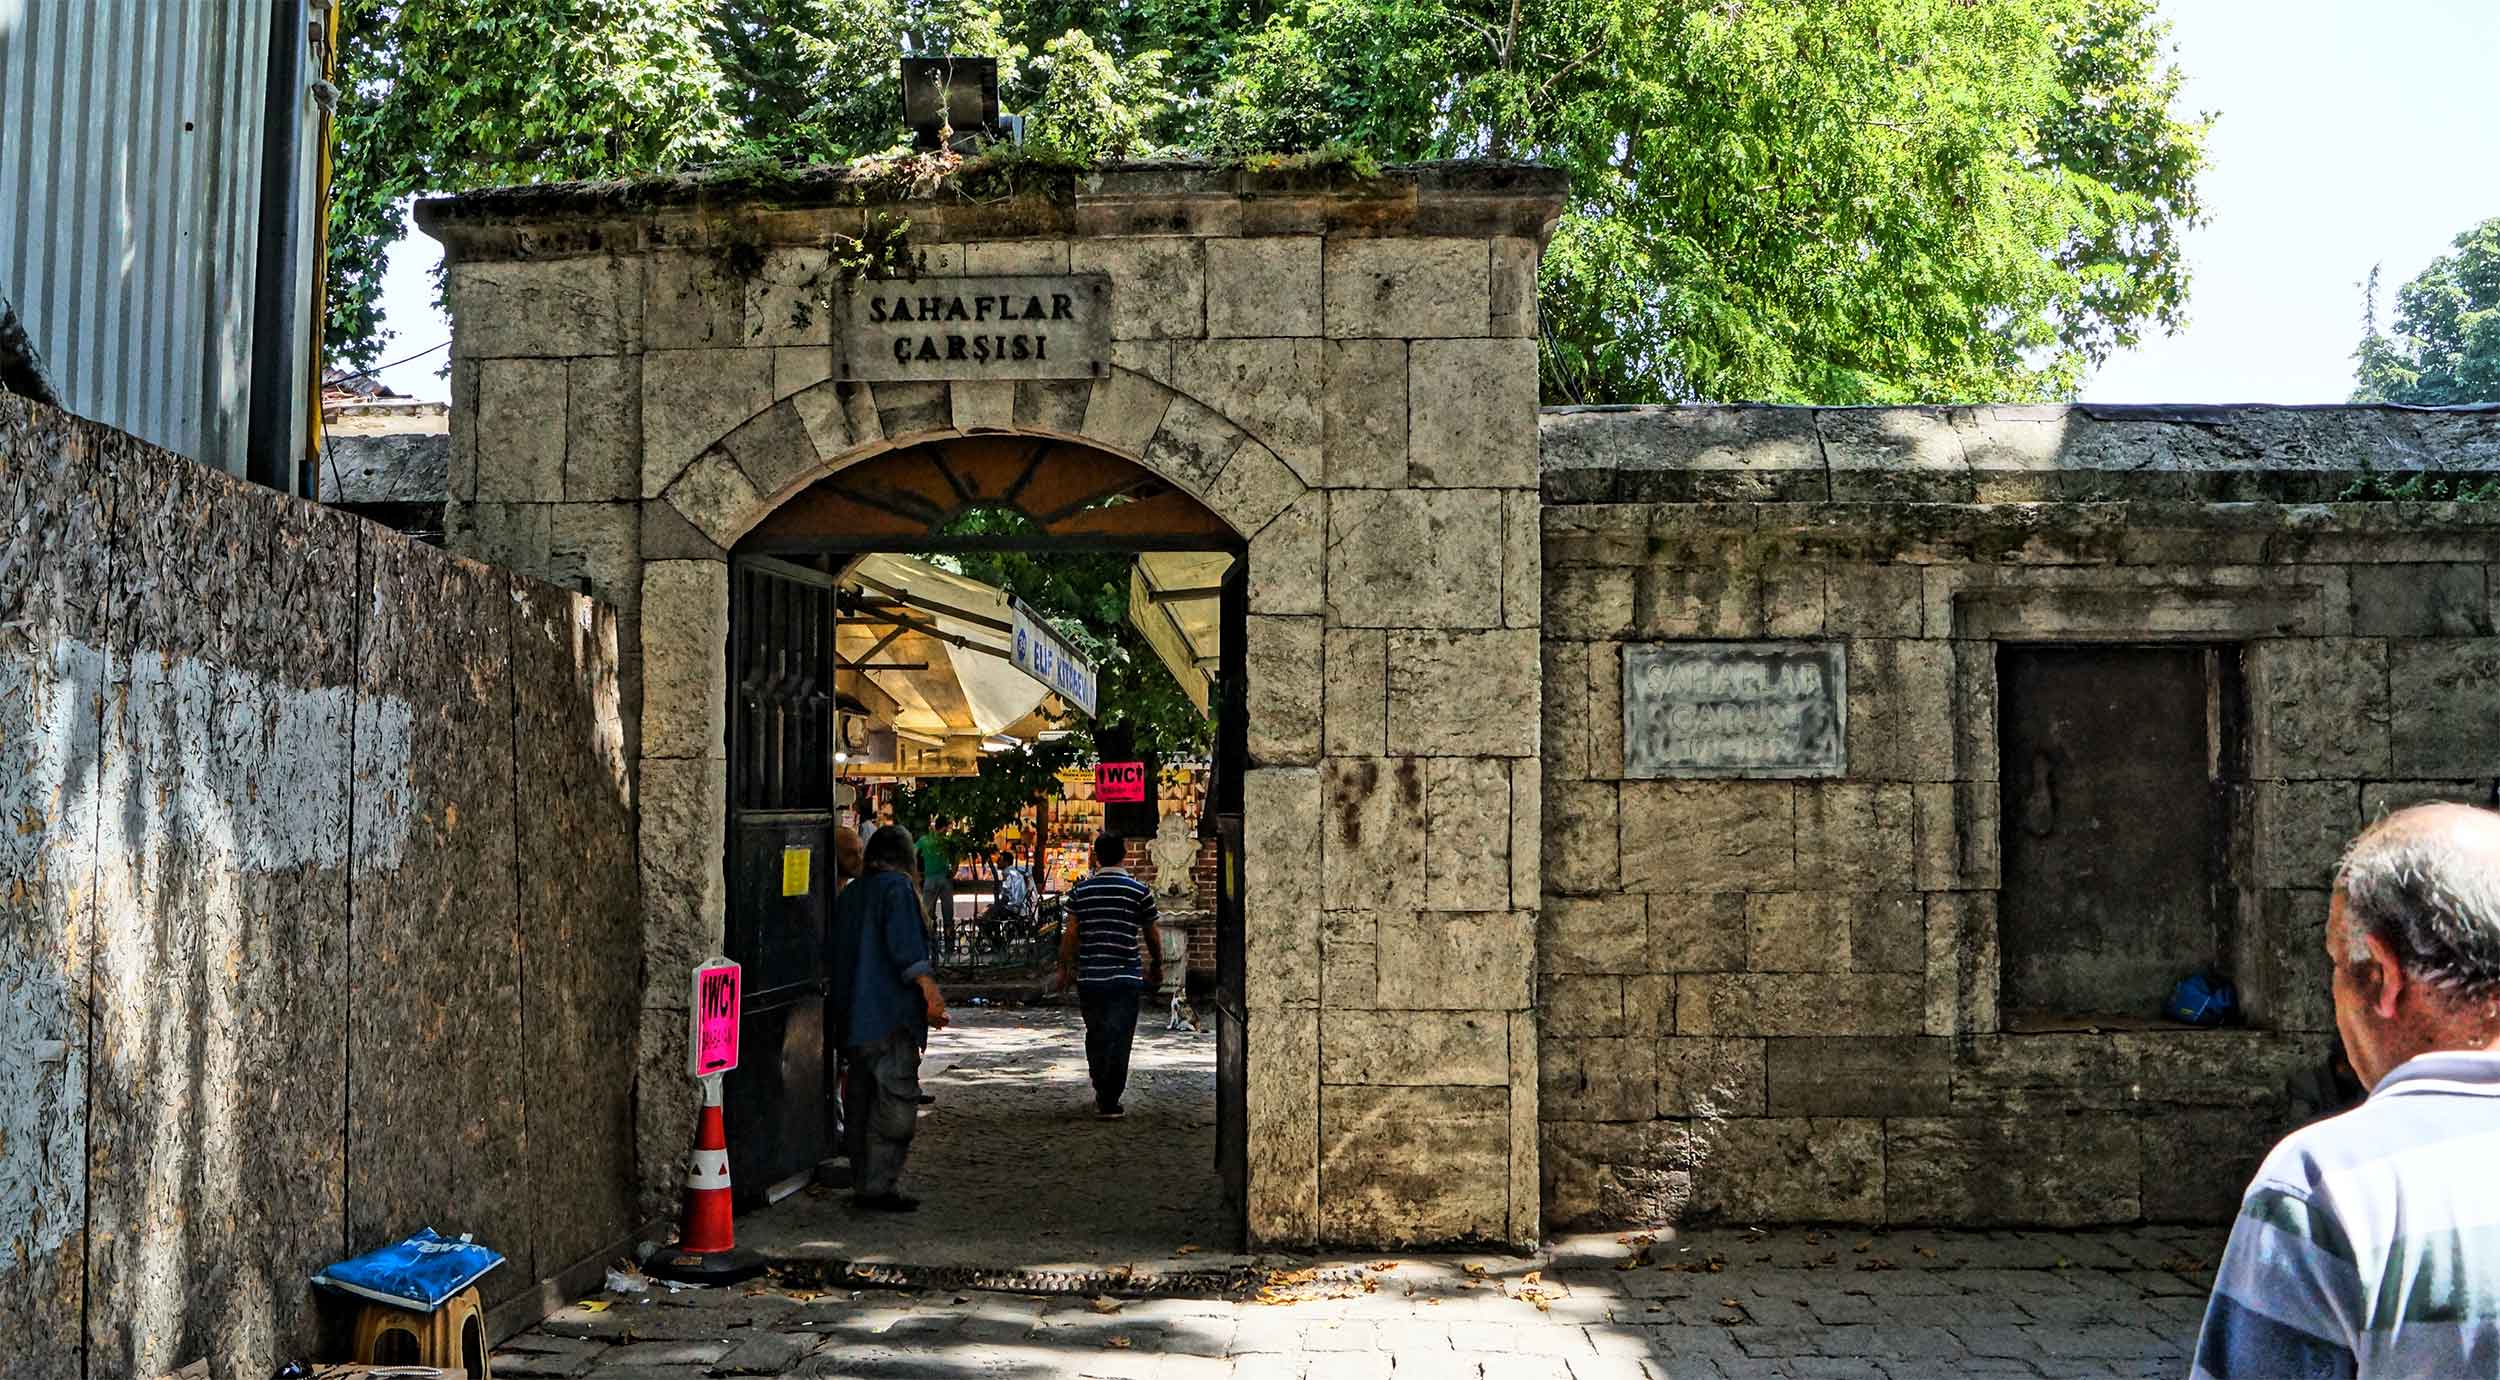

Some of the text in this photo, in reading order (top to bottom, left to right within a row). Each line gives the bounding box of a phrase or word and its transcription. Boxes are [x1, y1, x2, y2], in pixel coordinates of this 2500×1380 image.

[869, 293, 1074, 322] SAHAFLAR
[893, 335, 1048, 364] ÇARŞISI
[1107, 767, 1135, 784] WC
[708, 973, 729, 1018] WC
